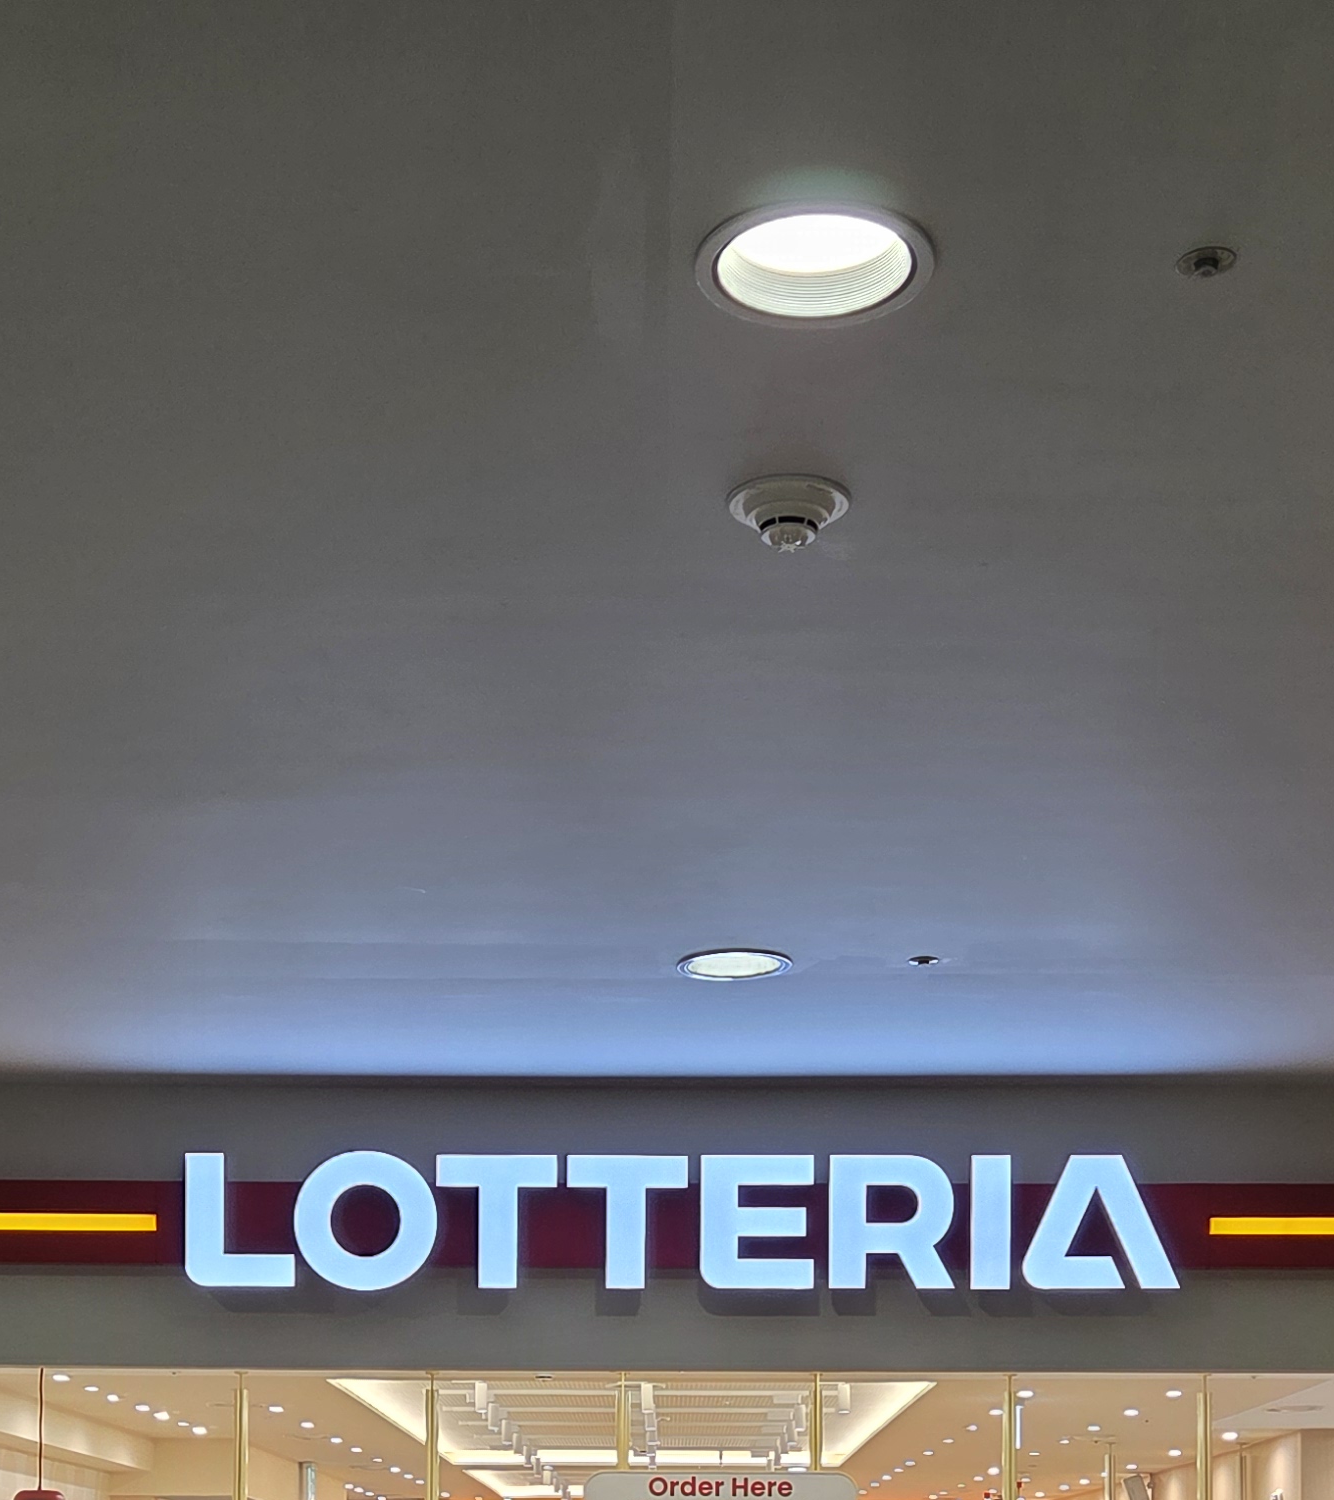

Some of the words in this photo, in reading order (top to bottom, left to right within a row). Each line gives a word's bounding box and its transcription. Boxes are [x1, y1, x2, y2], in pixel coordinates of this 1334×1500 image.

[184, 1150, 1181, 1291] LOTTERIA
[648, 1476, 724, 1498] Order
[731, 1477, 793, 1498] Here
